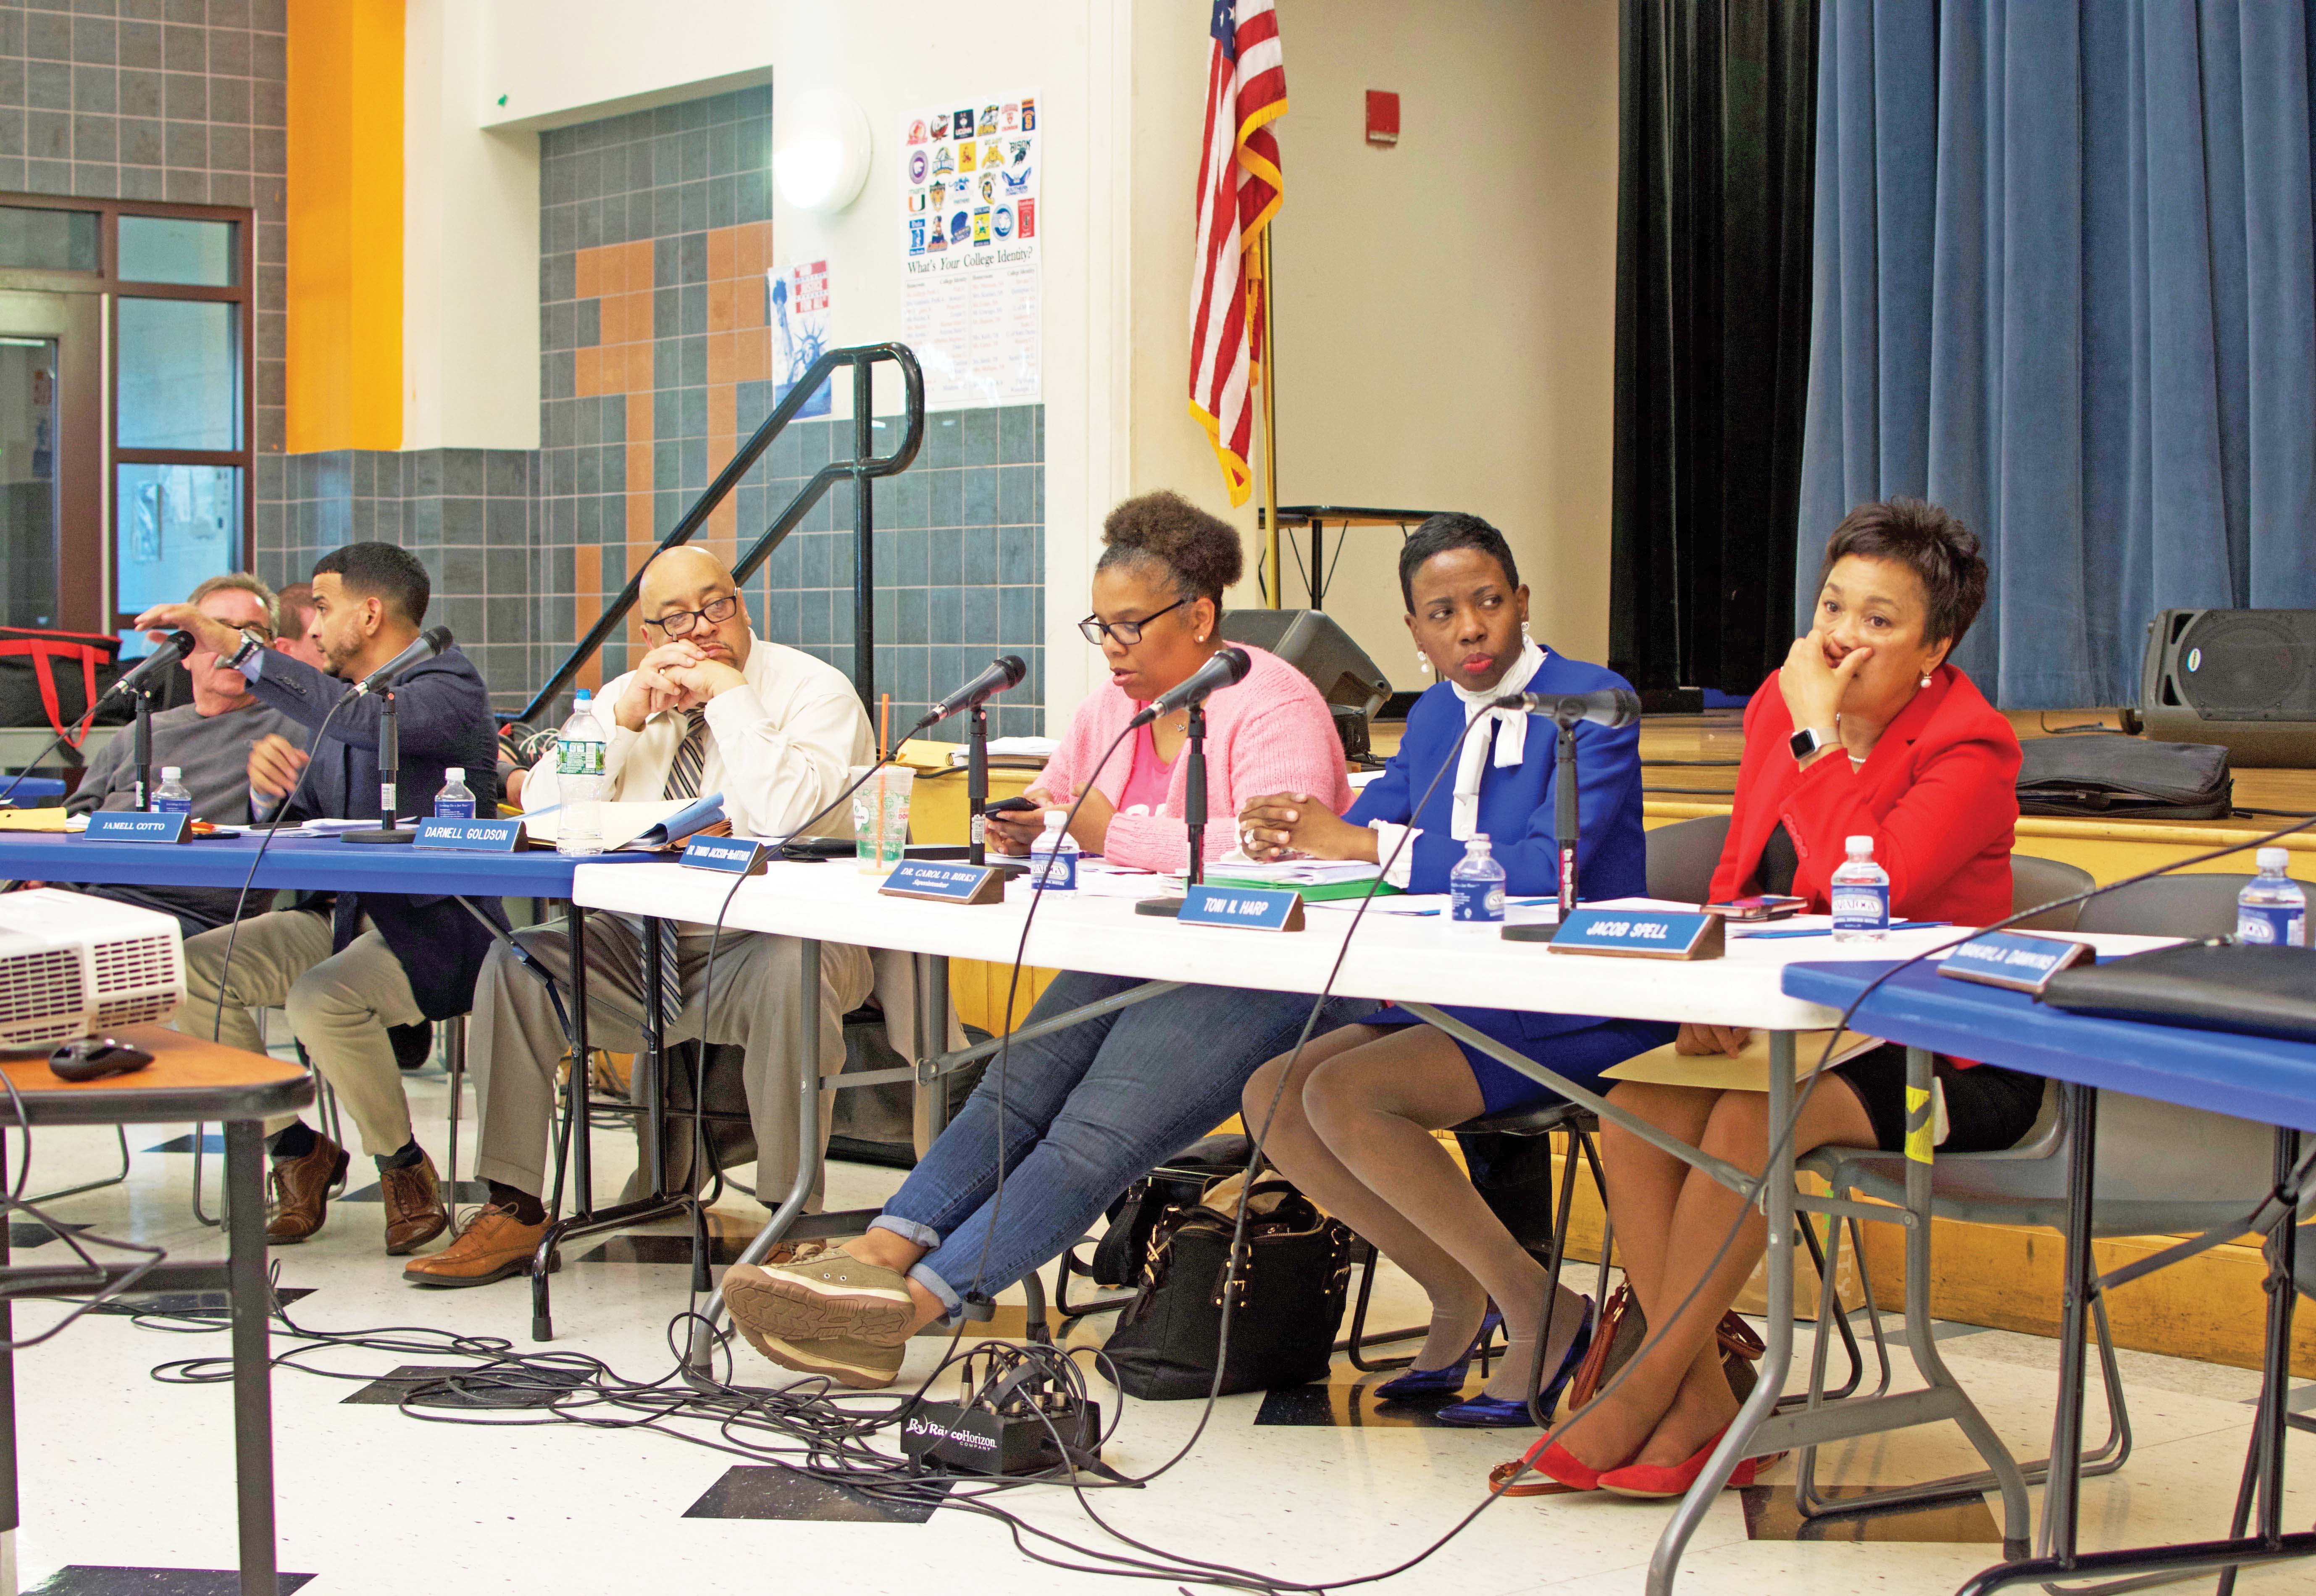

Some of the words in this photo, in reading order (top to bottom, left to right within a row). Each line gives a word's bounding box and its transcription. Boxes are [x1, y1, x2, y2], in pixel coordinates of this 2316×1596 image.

[1009, 138, 1032, 153] BISON
[908, 259, 936, 273] What's
[941, 257, 960, 270] Your
[964, 253, 994, 267] College
[997, 246, 1033, 263] Identity?
[425, 826, 462, 839] DARNELL
[467, 828, 508, 841] GOLDSON
[901, 868, 913, 876] DR.
[915, 869, 941, 879] CAROL
[950, 873, 977, 882] BIRKS
[1204, 897, 1227, 913] TONI
[1227, 899, 1238, 914] N.
[1239, 900, 1269, 915] HARP
[1586, 921, 1630, 937] JACOB
[1630, 923, 1668, 939] SPELL
[960, 1441, 991, 1451] COMPANY
